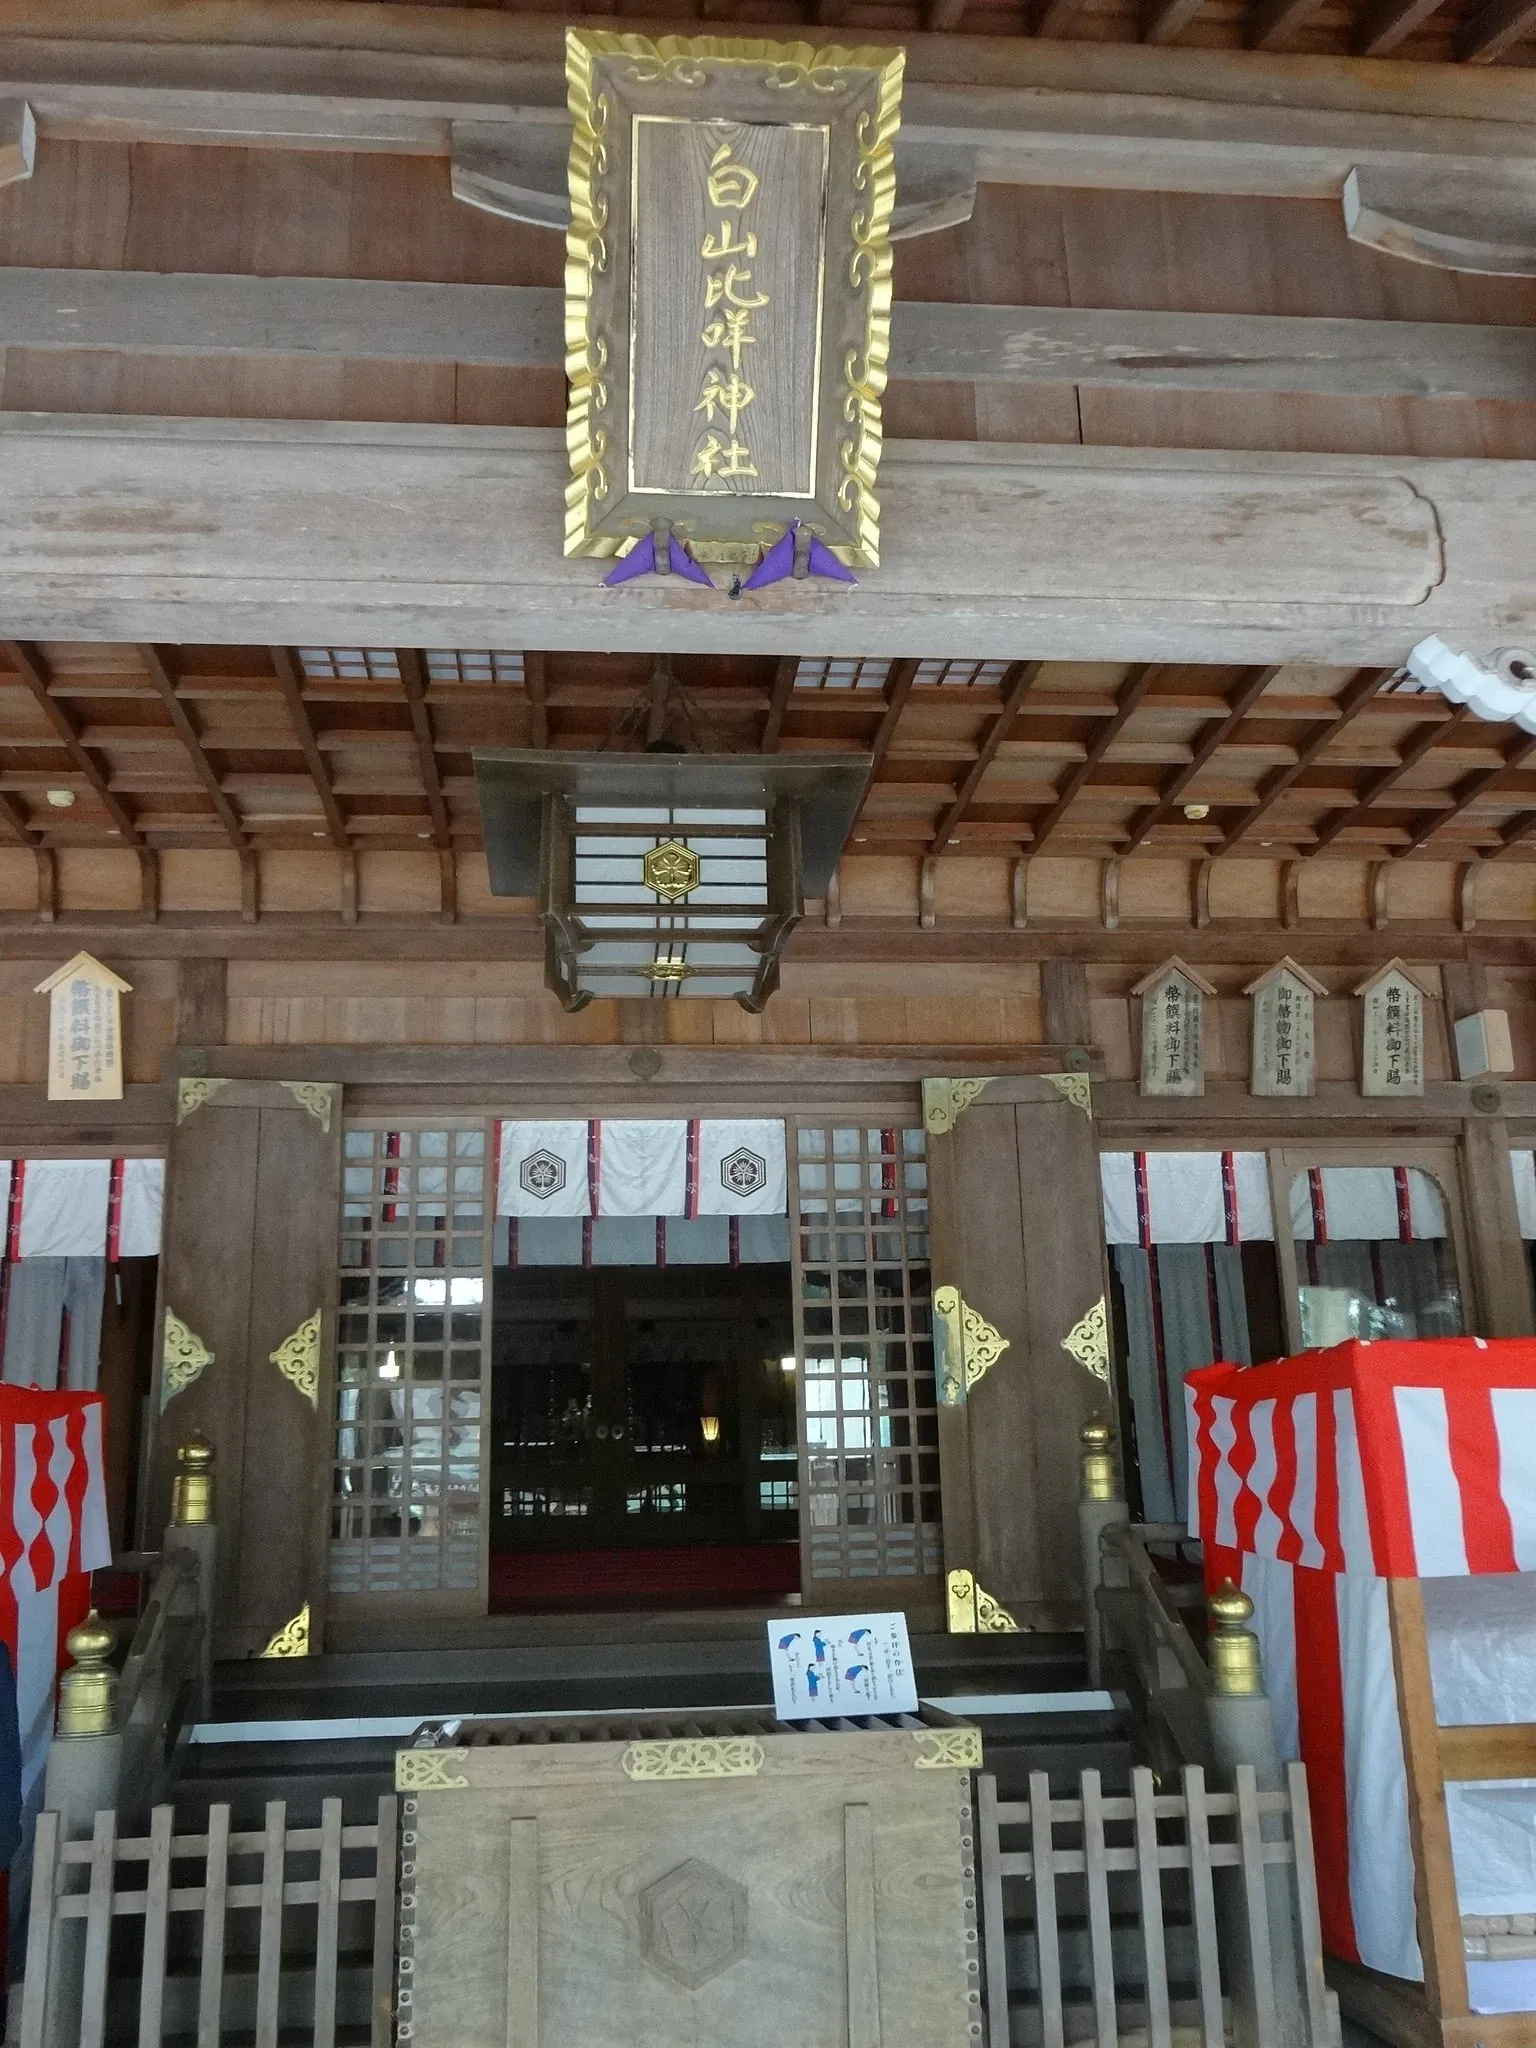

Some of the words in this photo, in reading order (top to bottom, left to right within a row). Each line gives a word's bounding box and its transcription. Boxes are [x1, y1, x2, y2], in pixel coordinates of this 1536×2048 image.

[693, 143, 770, 478] 白山比咩神社
